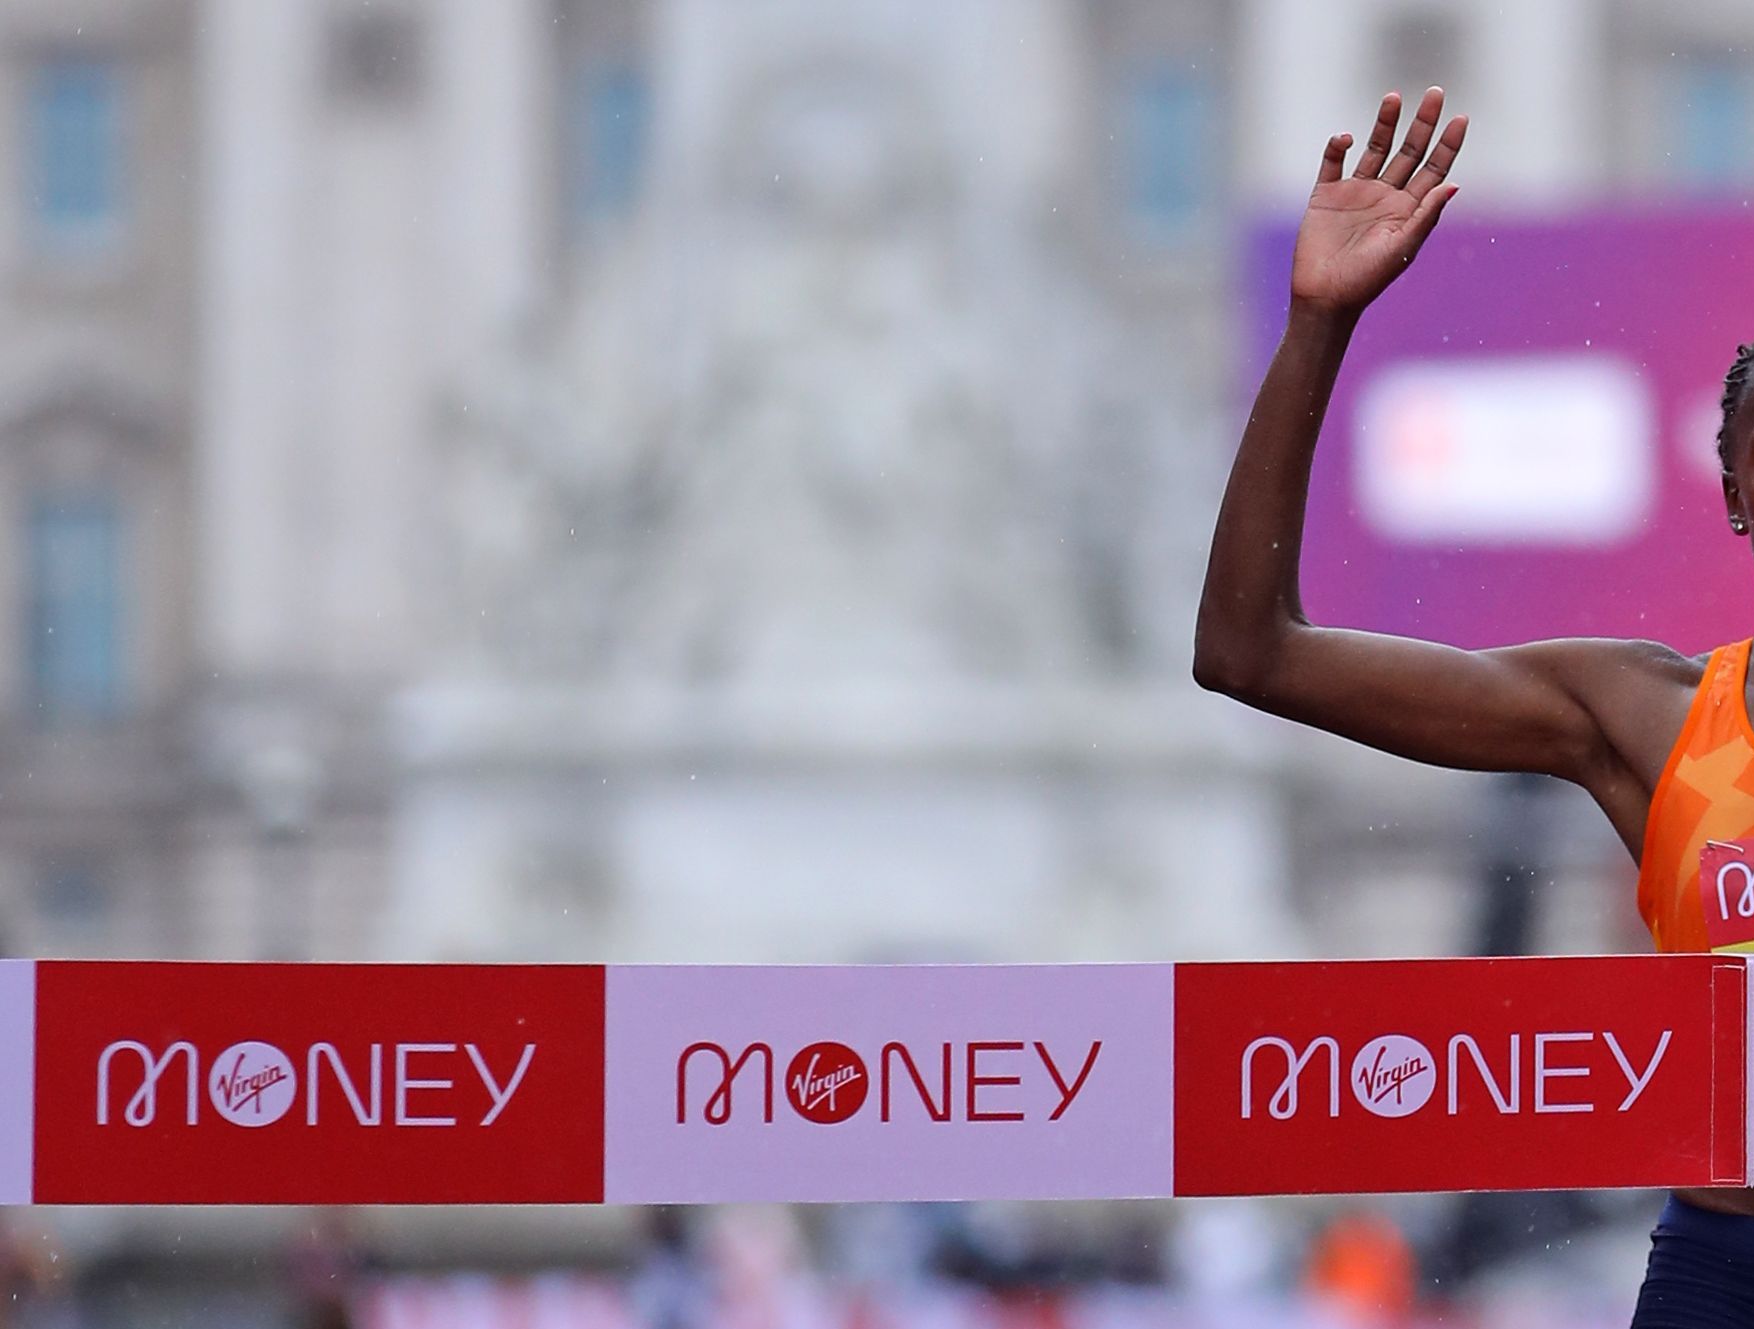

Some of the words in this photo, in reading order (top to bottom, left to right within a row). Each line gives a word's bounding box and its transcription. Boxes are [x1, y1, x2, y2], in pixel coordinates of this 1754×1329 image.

[98, 1041, 535, 1126] MONEY
[217, 1053, 287, 1113] Virgin
[677, 1041, 1102, 1125] MONEY
[793, 1054, 860, 1110] Virgin
[1242, 1031, 1672, 1119] MONEY
[1359, 1046, 1428, 1105] Virgin
